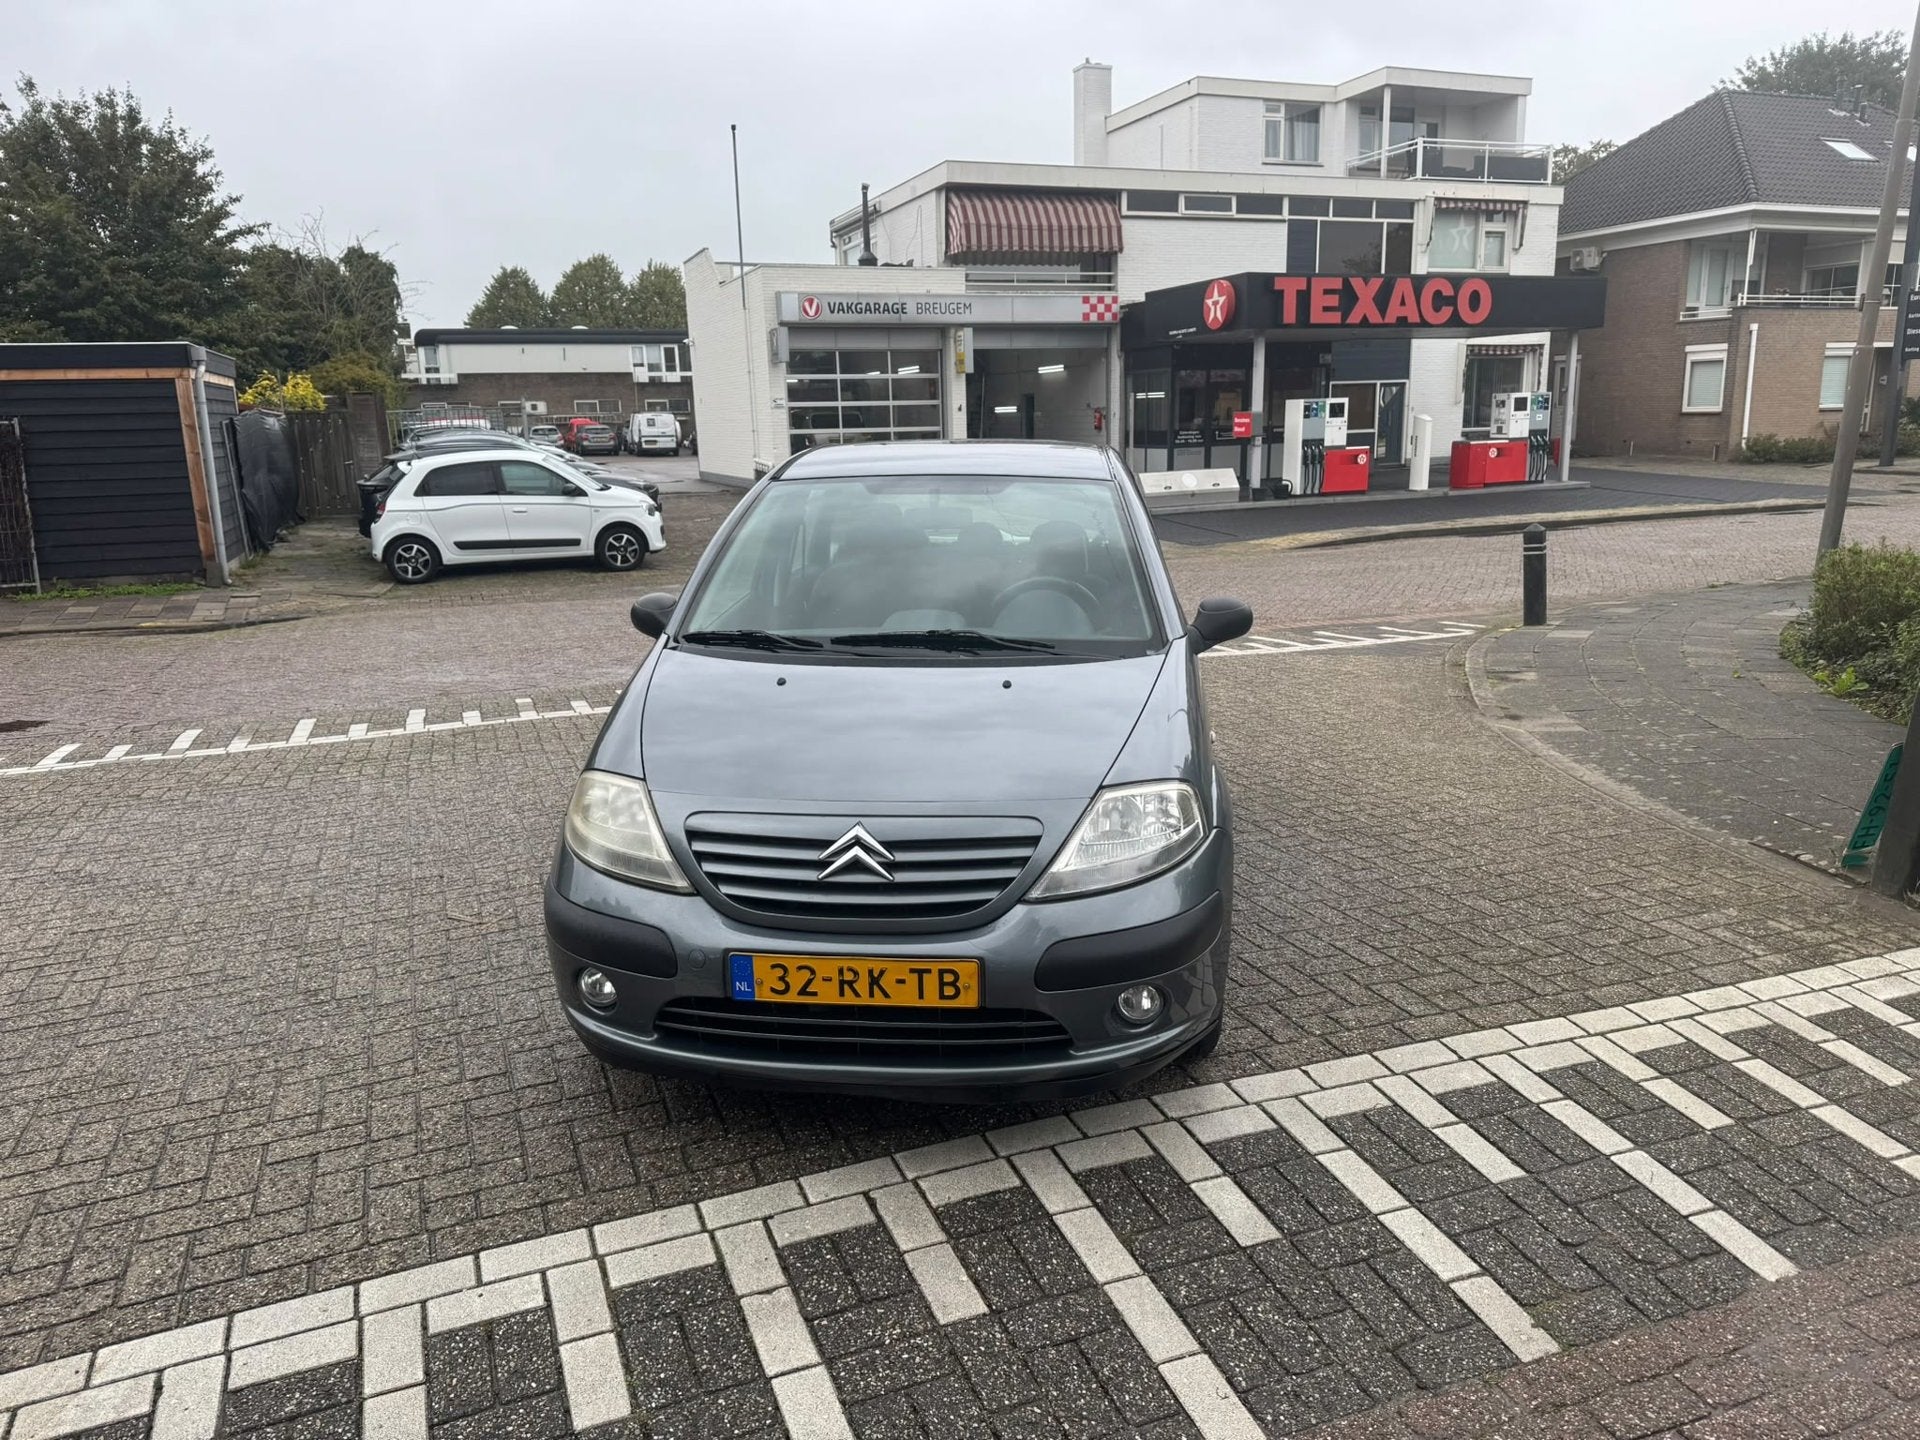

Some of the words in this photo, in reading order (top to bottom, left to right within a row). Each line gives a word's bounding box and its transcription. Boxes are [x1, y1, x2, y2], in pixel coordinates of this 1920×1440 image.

[827, 301, 908, 315] VAKGARAGE
[916, 302, 972, 315] BREUGEM
[1274, 276, 1493, 325] TEXACO
[735, 980, 752, 992] NL
[769, 963, 962, 1001] 32-RK-TB
